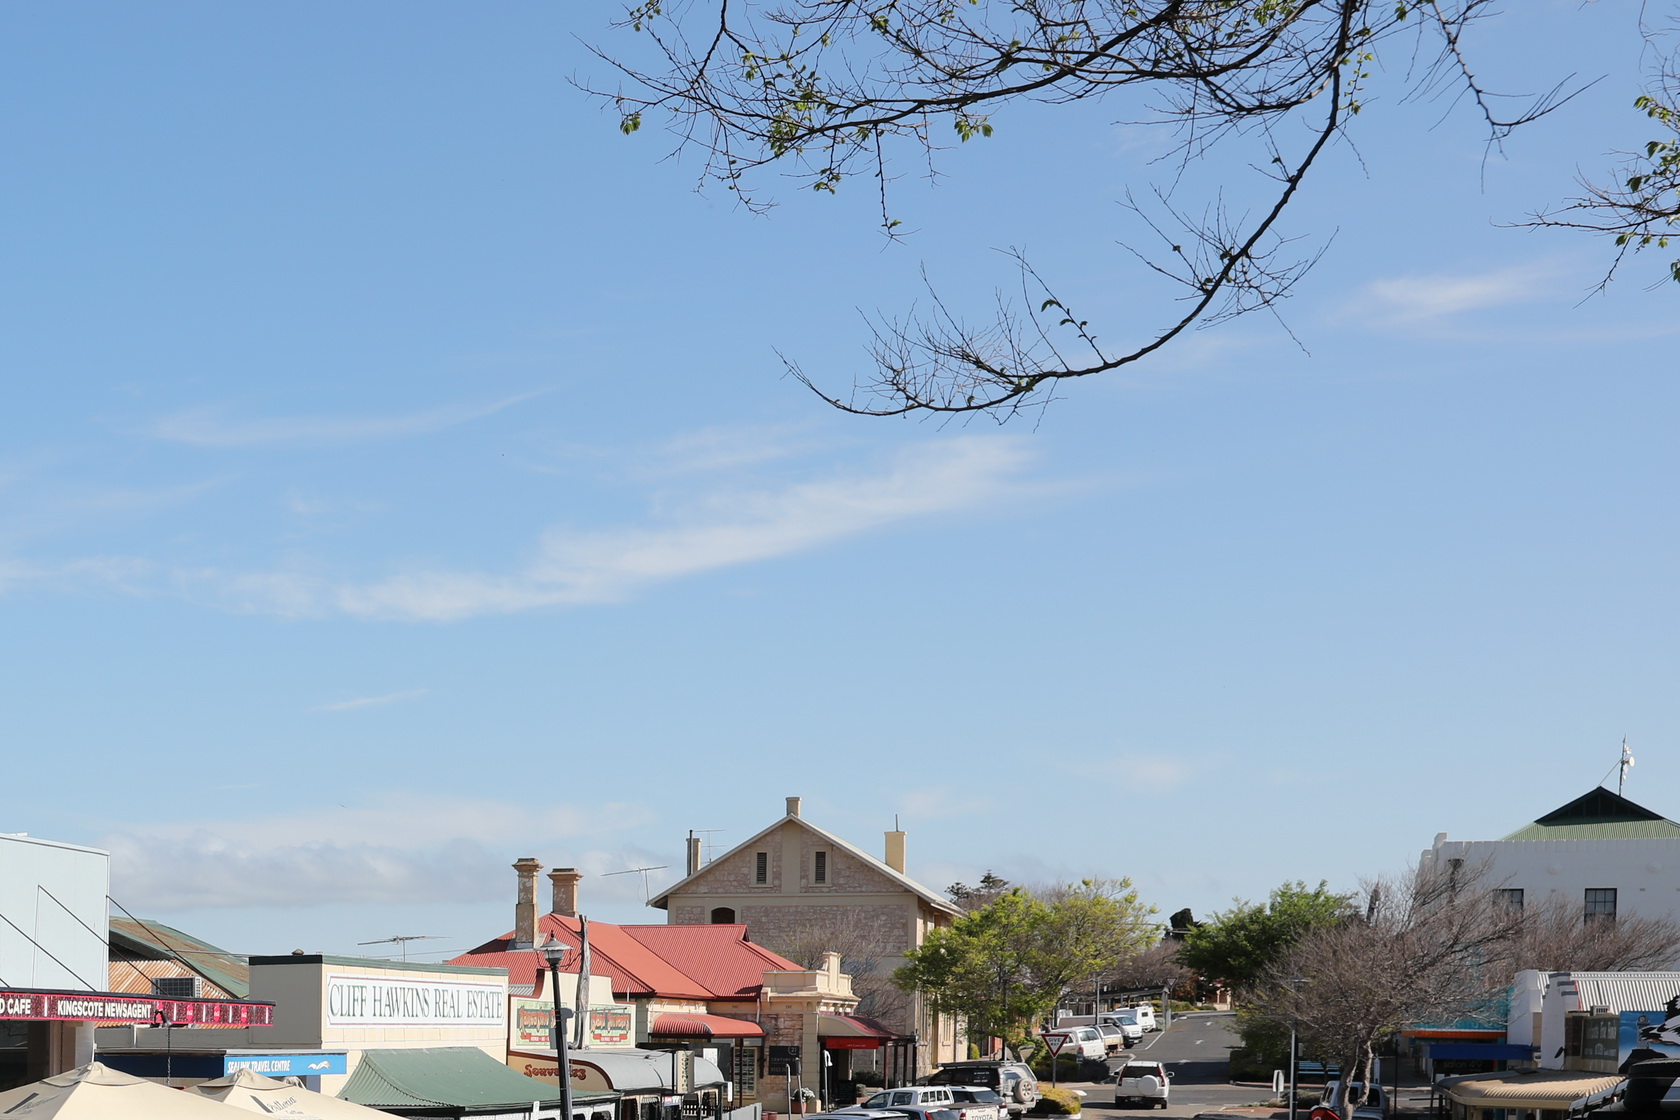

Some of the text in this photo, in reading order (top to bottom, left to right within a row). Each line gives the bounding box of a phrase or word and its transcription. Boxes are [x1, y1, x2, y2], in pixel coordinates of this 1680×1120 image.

[7, 998, 31, 1015] CAFE
[57, 1001, 104, 1017] KINGSCOTE
[105, 1002, 152, 1019] NEWSAGENT
[330, 984, 502, 1018] CLIFF HAWKINS REAL ESTATE
[251, 1061, 271, 1073] TRAVEL
[271, 1060, 291, 1072] CENTRE
